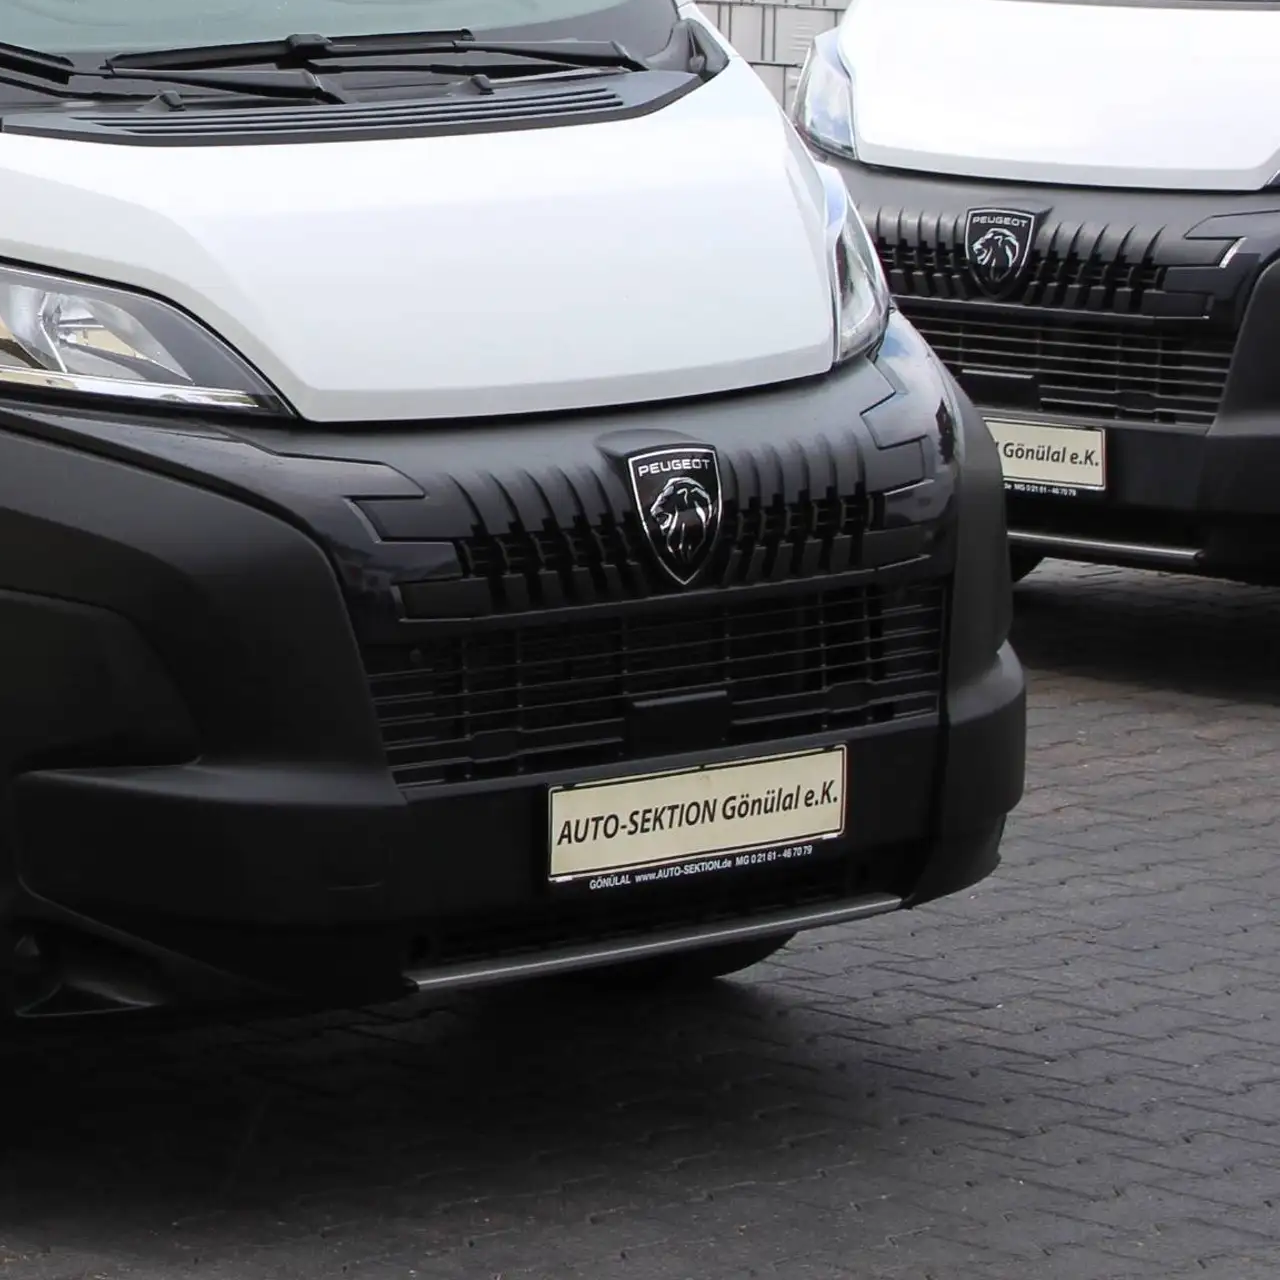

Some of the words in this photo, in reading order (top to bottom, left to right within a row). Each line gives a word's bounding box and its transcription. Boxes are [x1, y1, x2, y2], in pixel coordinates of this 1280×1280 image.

[972, 216, 1028, 227] PEUGEOT
[1003, 442, 1066, 463] Gönülal
[1070, 449, 1099, 466] e.K.
[638, 459, 710, 477] PEUGEOT
[557, 798, 717, 846] AUTO-SEKTION
[722, 784, 801, 820] Gönülal
[804, 779, 838, 808] e.K.
[589, 874, 631, 890] GÖNÜLAL
[634, 858, 732, 883] www.AUTO-SEKTION.de
[735, 854, 749, 866] MG
